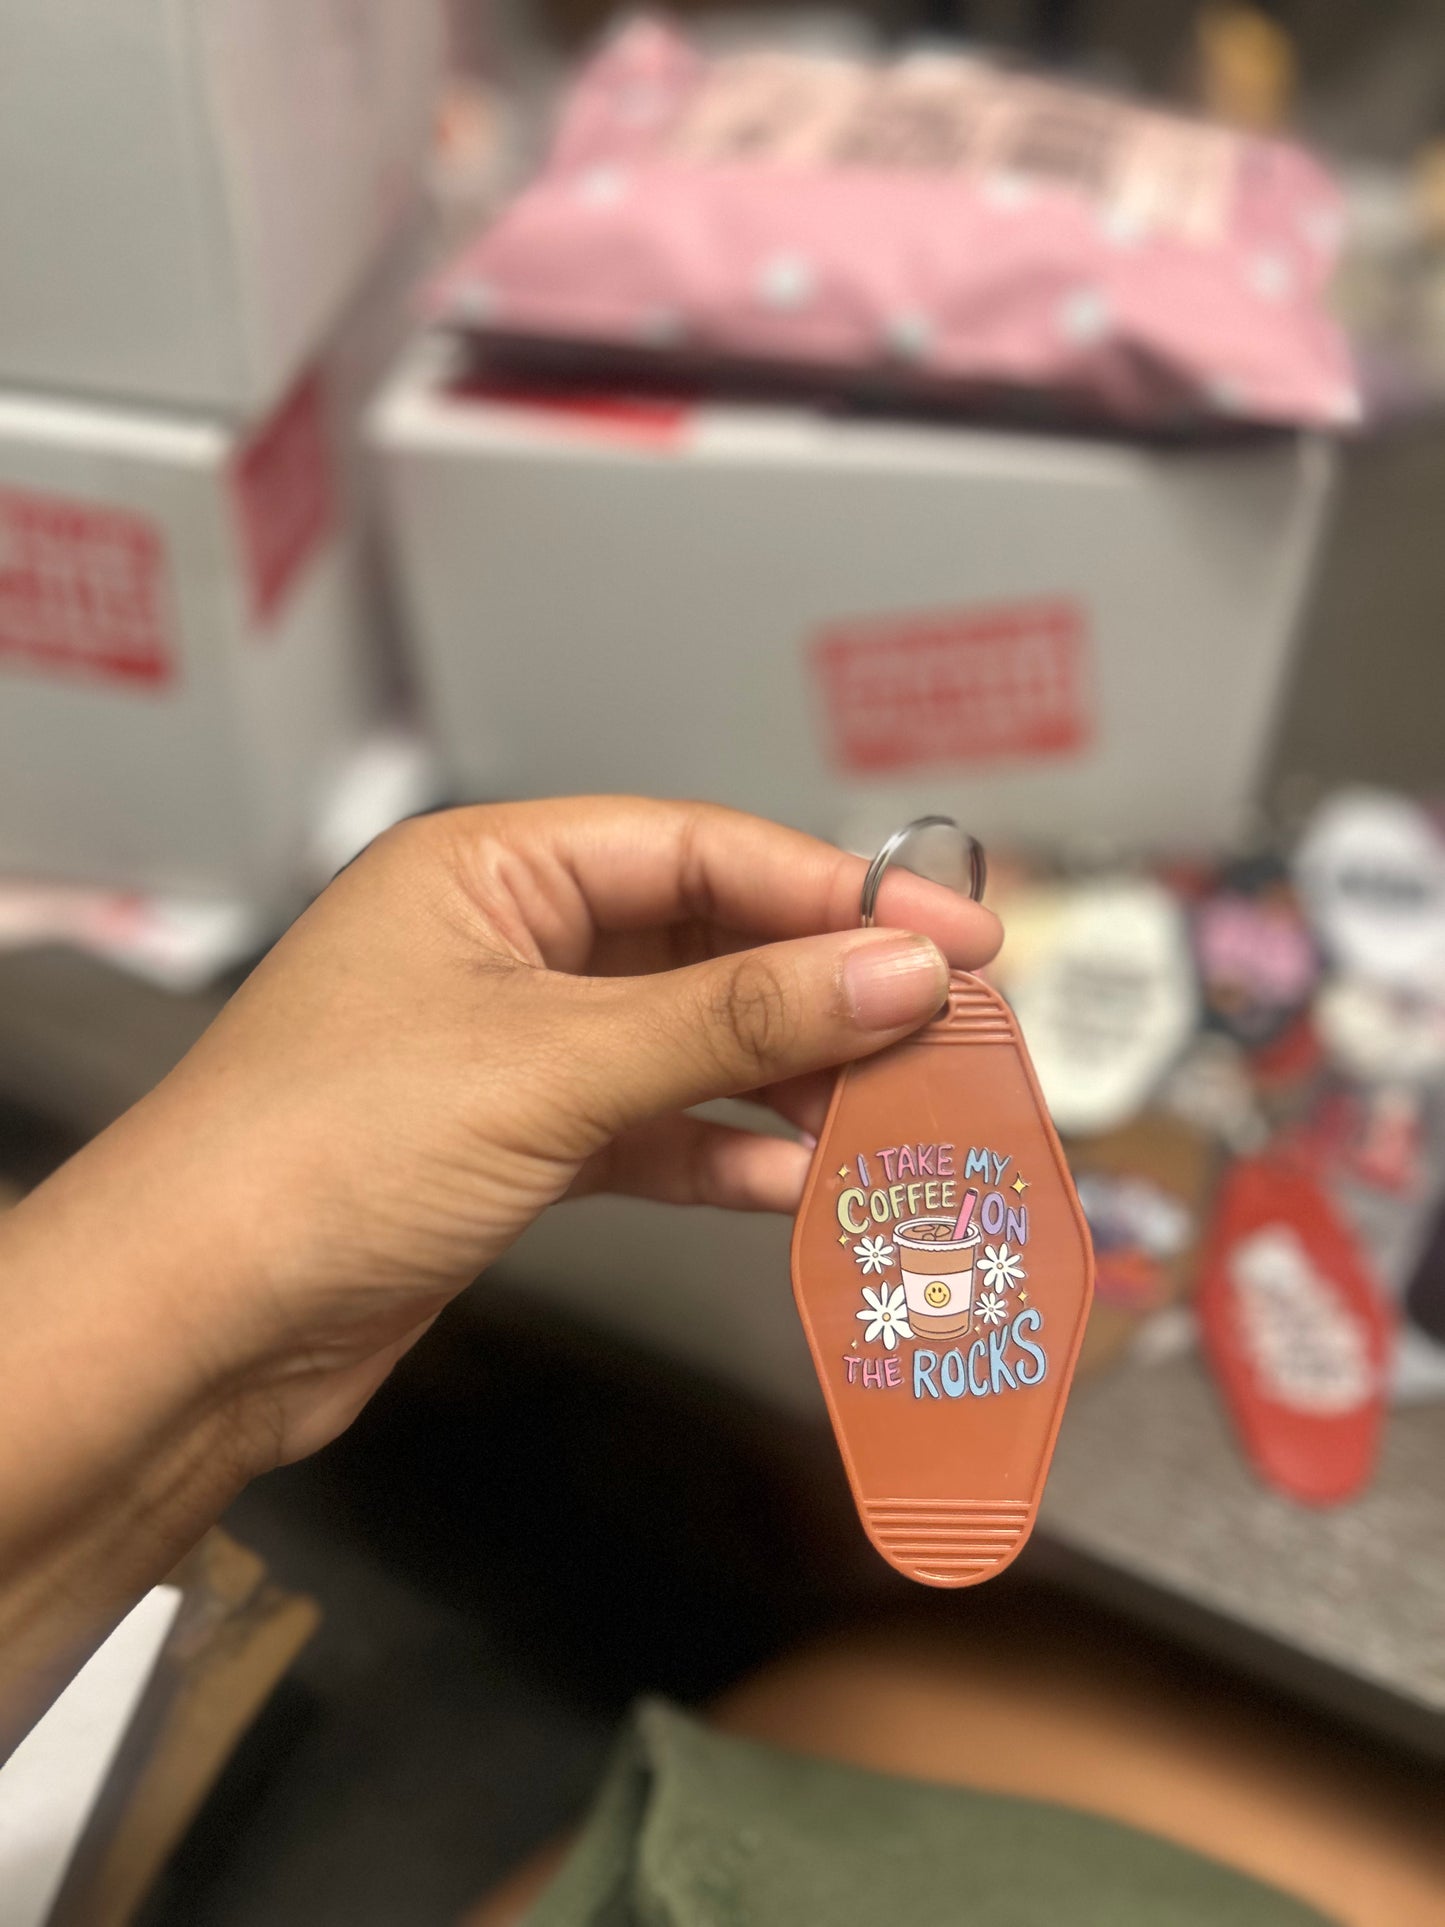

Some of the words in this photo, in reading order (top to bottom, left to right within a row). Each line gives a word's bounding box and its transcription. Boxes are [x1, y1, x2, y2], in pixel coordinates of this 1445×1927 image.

[857, 1153, 870, 1188] I
[876, 1144, 955, 1182] TAKE
[965, 1147, 1011, 1186] MY
[837, 1181, 956, 1234] COFFEE
[981, 1192, 1027, 1246] ON
[843, 1355, 902, 1388] THE
[913, 1309, 1046, 1399] ROCKS
